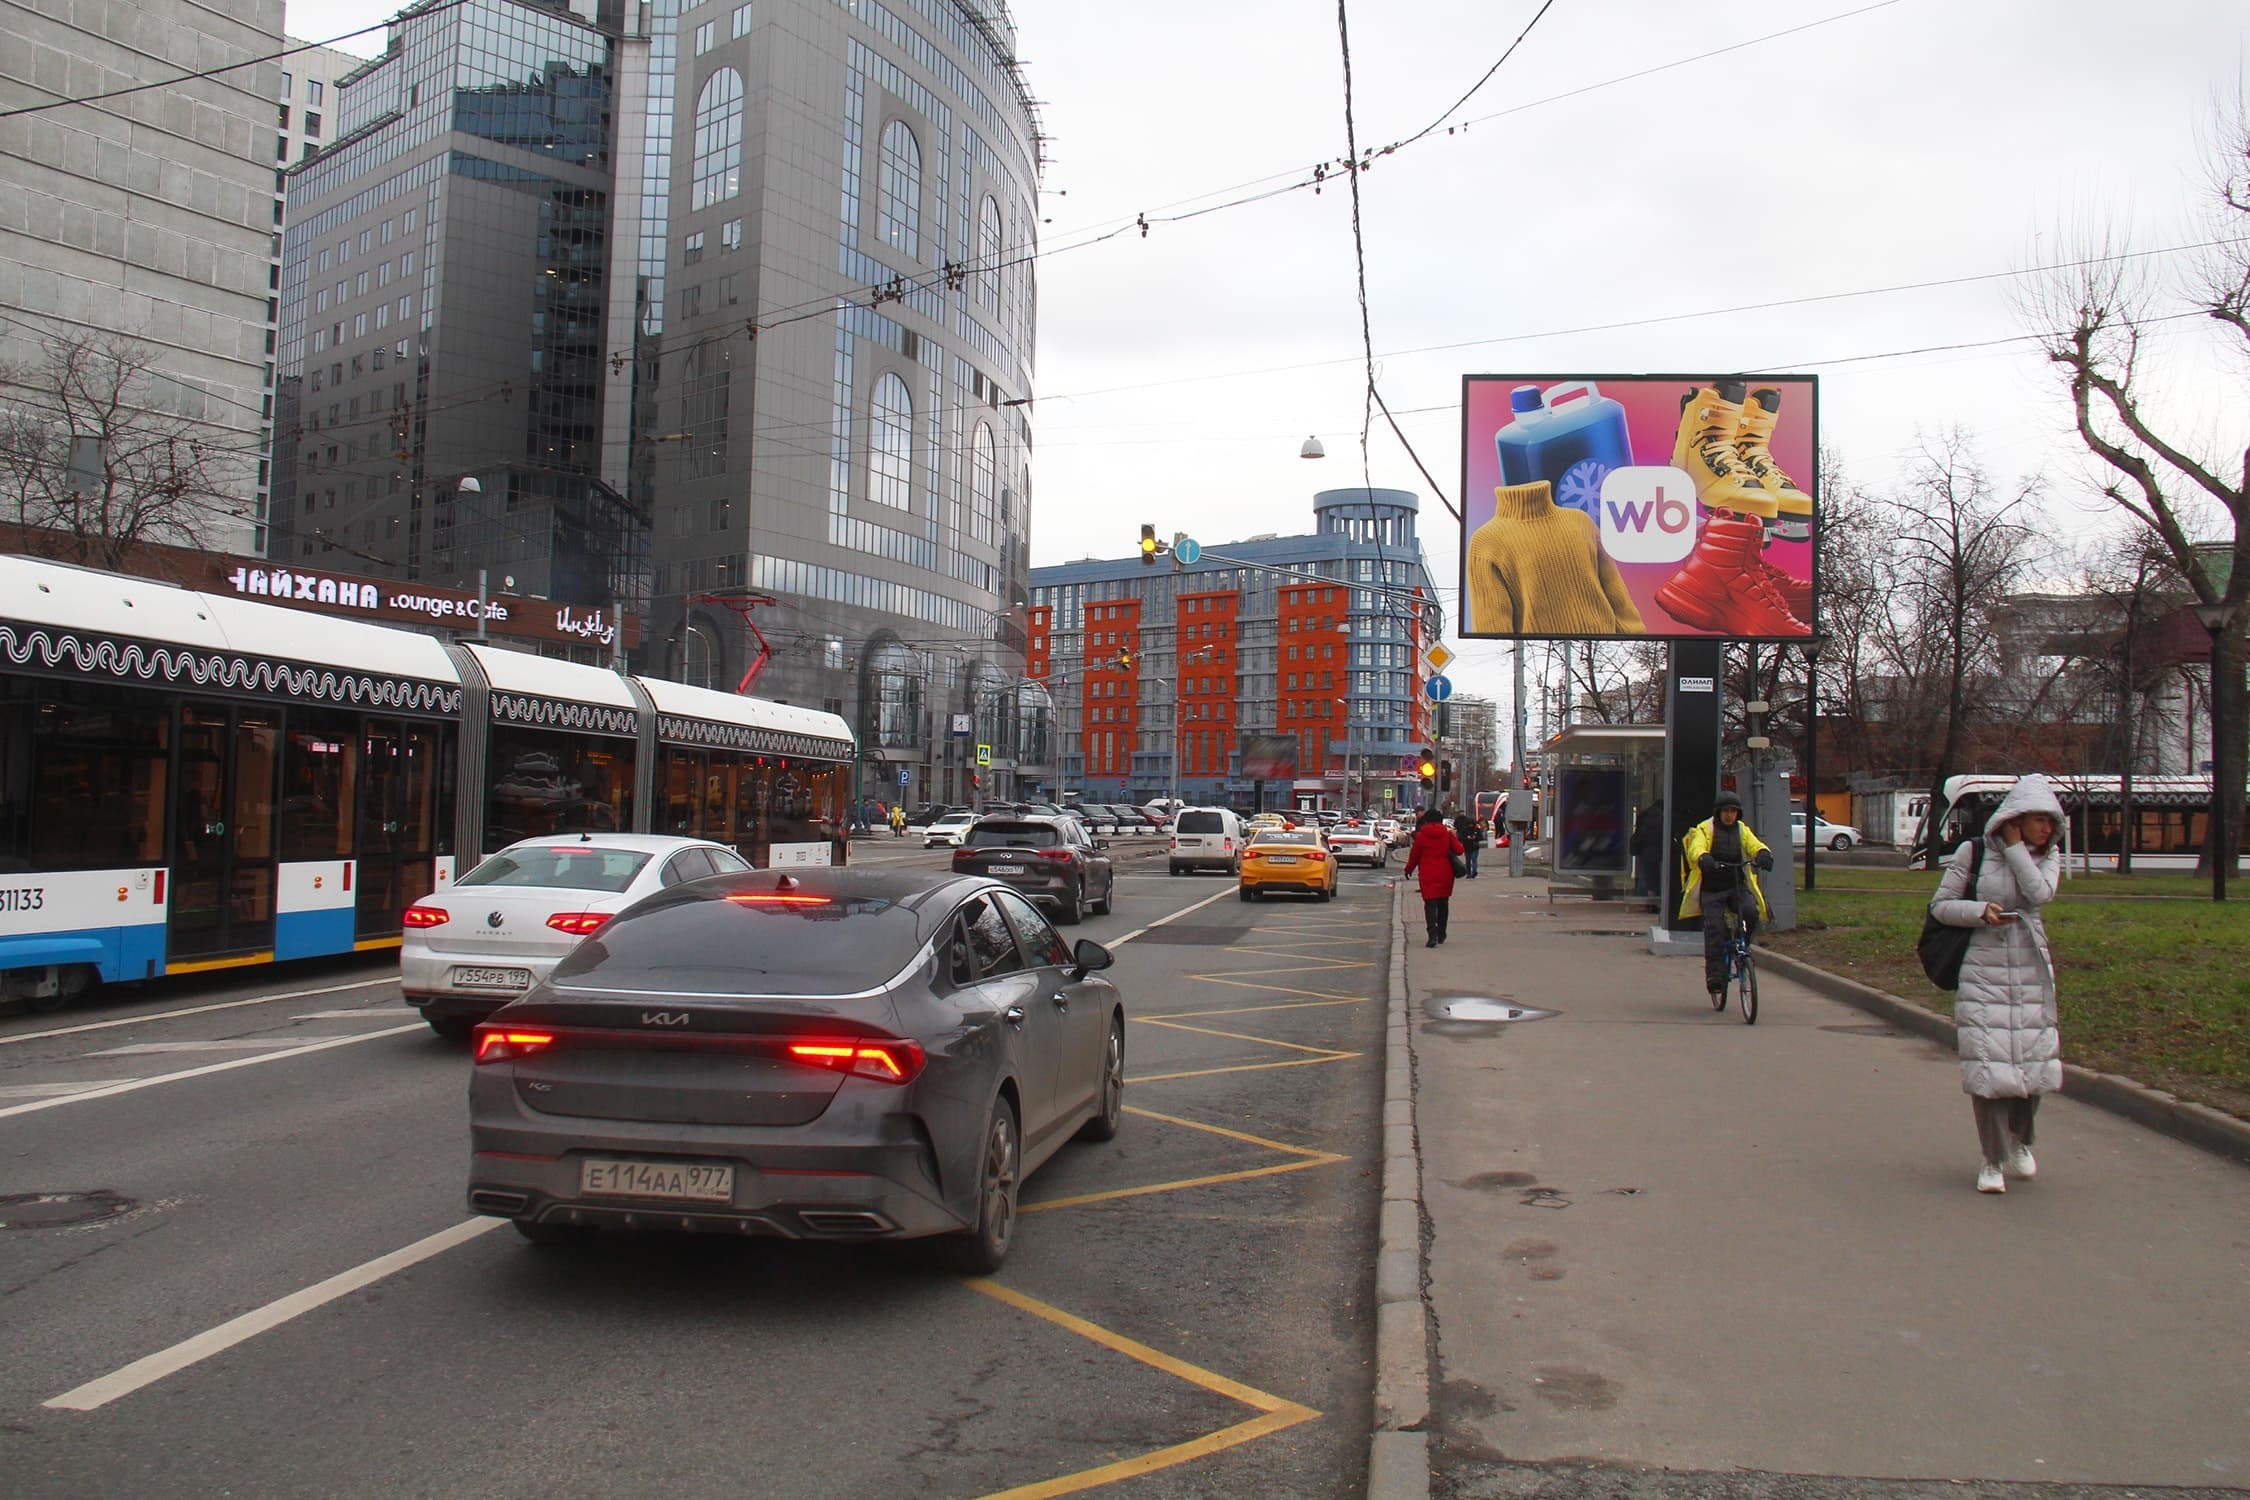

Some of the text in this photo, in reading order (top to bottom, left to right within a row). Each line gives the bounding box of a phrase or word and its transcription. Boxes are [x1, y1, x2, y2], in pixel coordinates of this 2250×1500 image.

[1606, 486, 1690, 534] wb
[455, 601, 466, 616] &
[508, 971, 527, 981] 199
[590, 1163, 726, 1193] Е114АА 977
